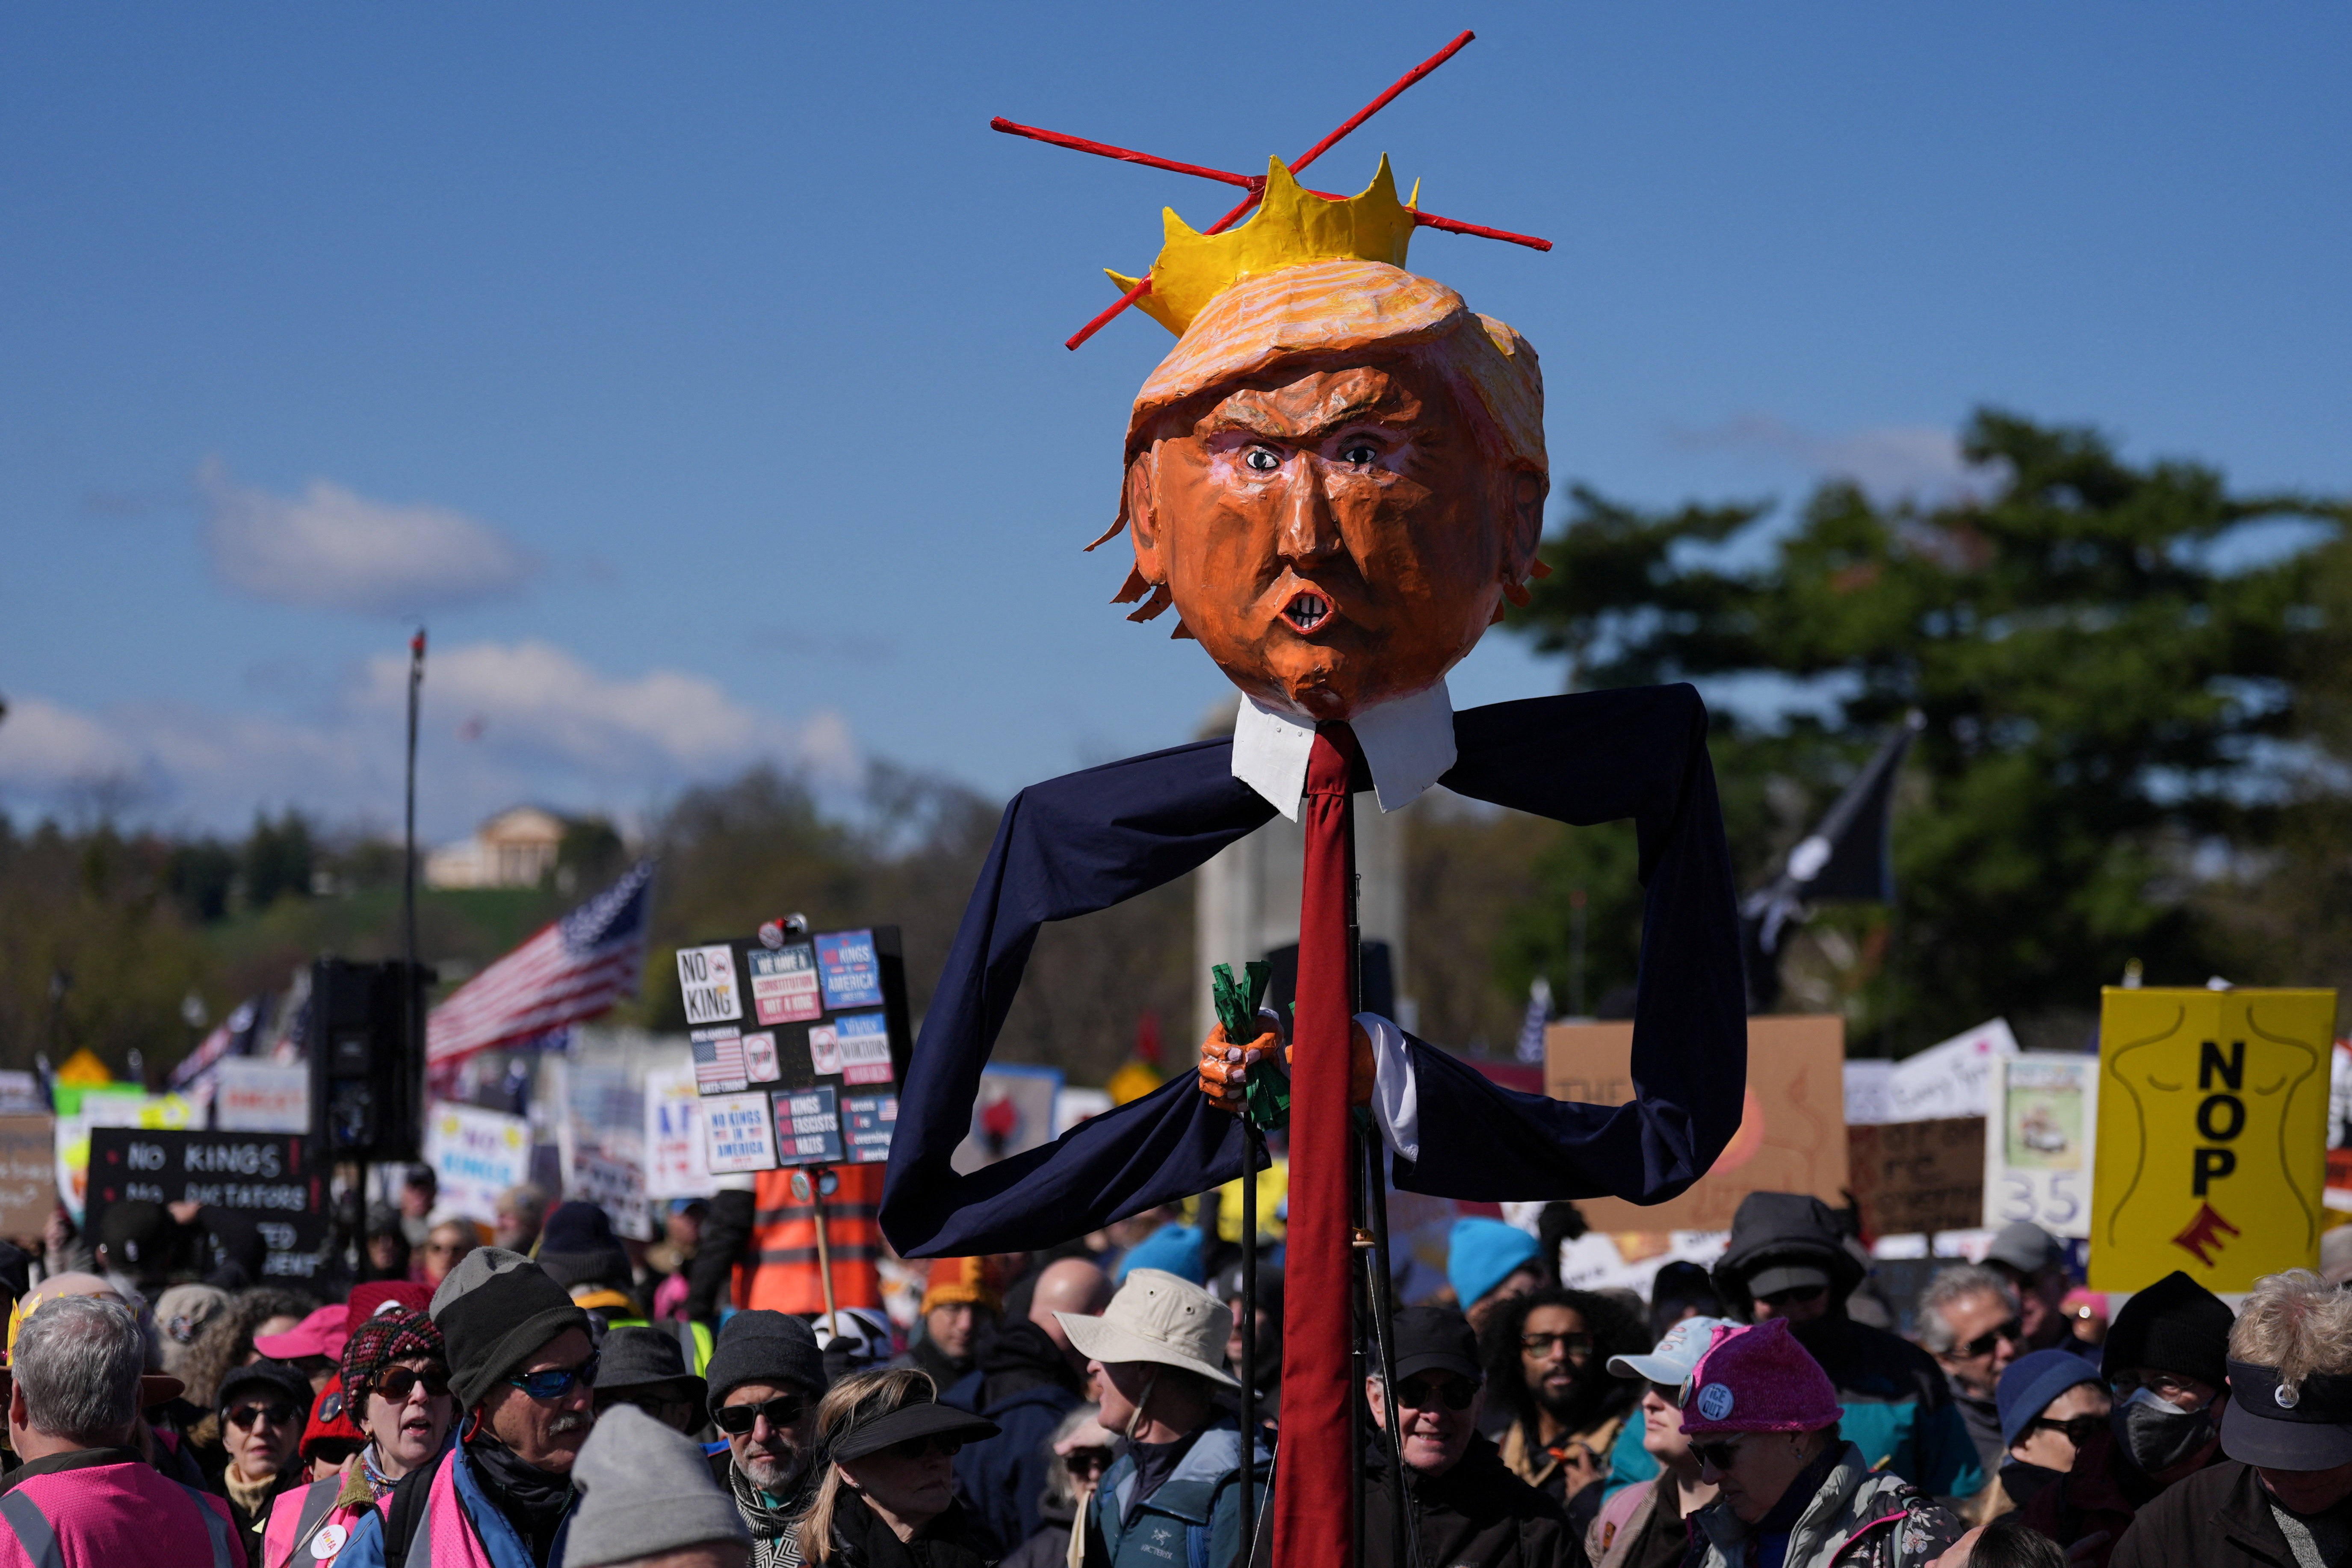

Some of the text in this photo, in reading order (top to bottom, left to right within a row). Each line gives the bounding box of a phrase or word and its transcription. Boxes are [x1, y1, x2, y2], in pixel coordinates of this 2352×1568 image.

[757, 953, 807, 974] WE HAVE A
[839, 945, 871, 965] KINGS
[682, 953, 706, 983] NO
[756, 975, 813, 993] CONSTITUTION
[828, 973, 874, 993] AMERICA
[687, 988, 731, 1019] KING
[763, 995, 814, 1015] NOT A KING
[750, 1051, 771, 1066] TRUMP
[790, 1095, 821, 1117] KINGS
[712, 1110, 761, 1128] NO KINGS
[792, 1113, 838, 1135] FASCISTS
[854, 1115, 871, 1128] Are
[733, 1128, 742, 1140] IN
[717, 1141, 764, 1158] AMERICA
[795, 1134, 826, 1155] NAZIS
[127, 1141, 167, 1171] NO
[126, 1181, 164, 1204] NO
[1709, 1386, 1727, 1403] ICE
[1702, 1400, 1724, 1418] OUT
